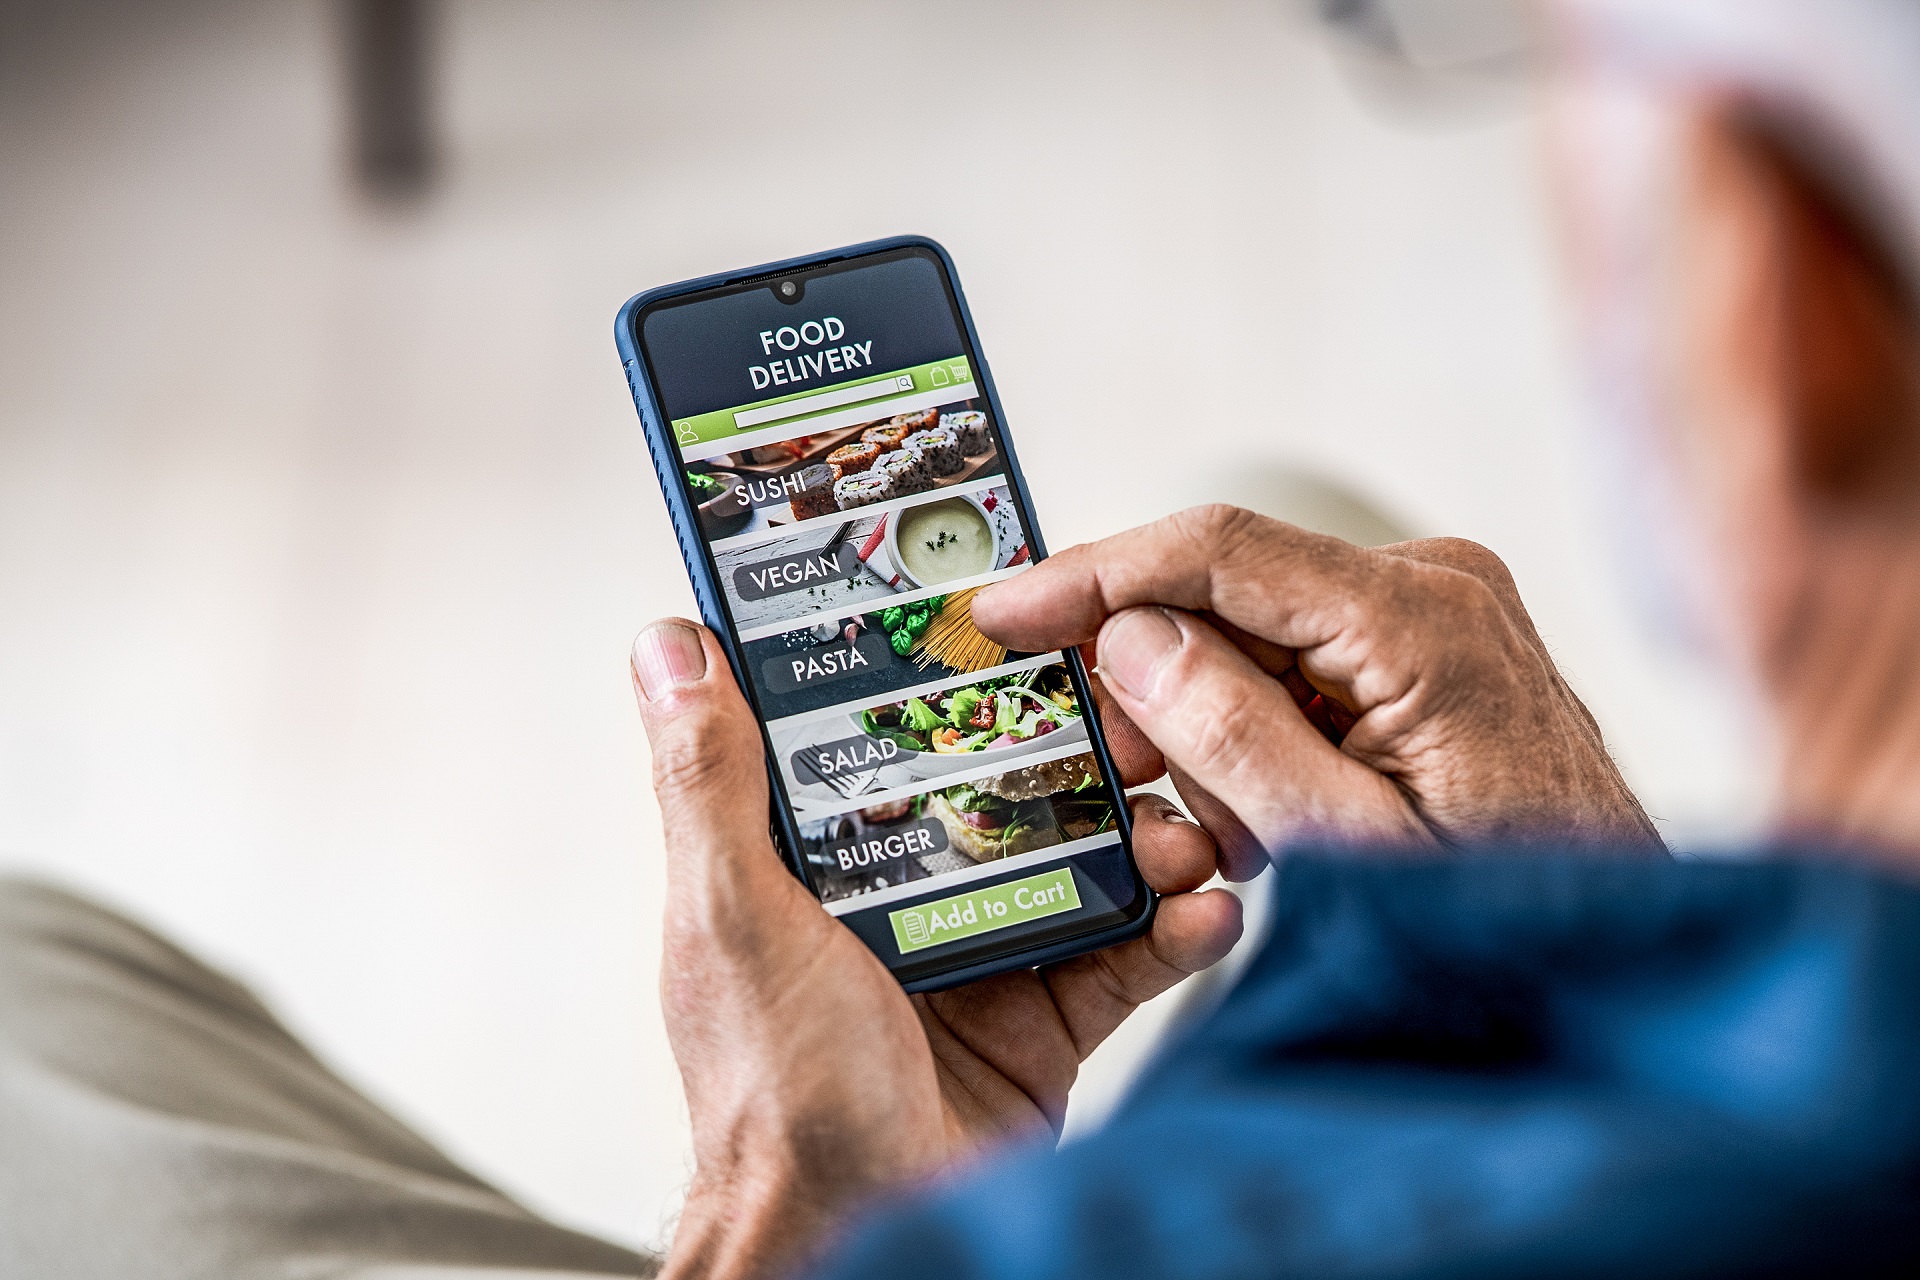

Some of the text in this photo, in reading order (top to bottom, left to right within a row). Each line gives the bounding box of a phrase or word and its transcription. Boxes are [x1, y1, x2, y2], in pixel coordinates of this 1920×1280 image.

[759, 316, 845, 357] FOOD
[748, 340, 873, 391] DELIVERY
[734, 471, 808, 507] SUSHI
[750, 552, 842, 593] VEGAN
[792, 646, 868, 682] PASTA
[818, 737, 898, 775] SALAD
[836, 828, 935, 871] BURGER
[929, 881, 1066, 934] Add to Cart
